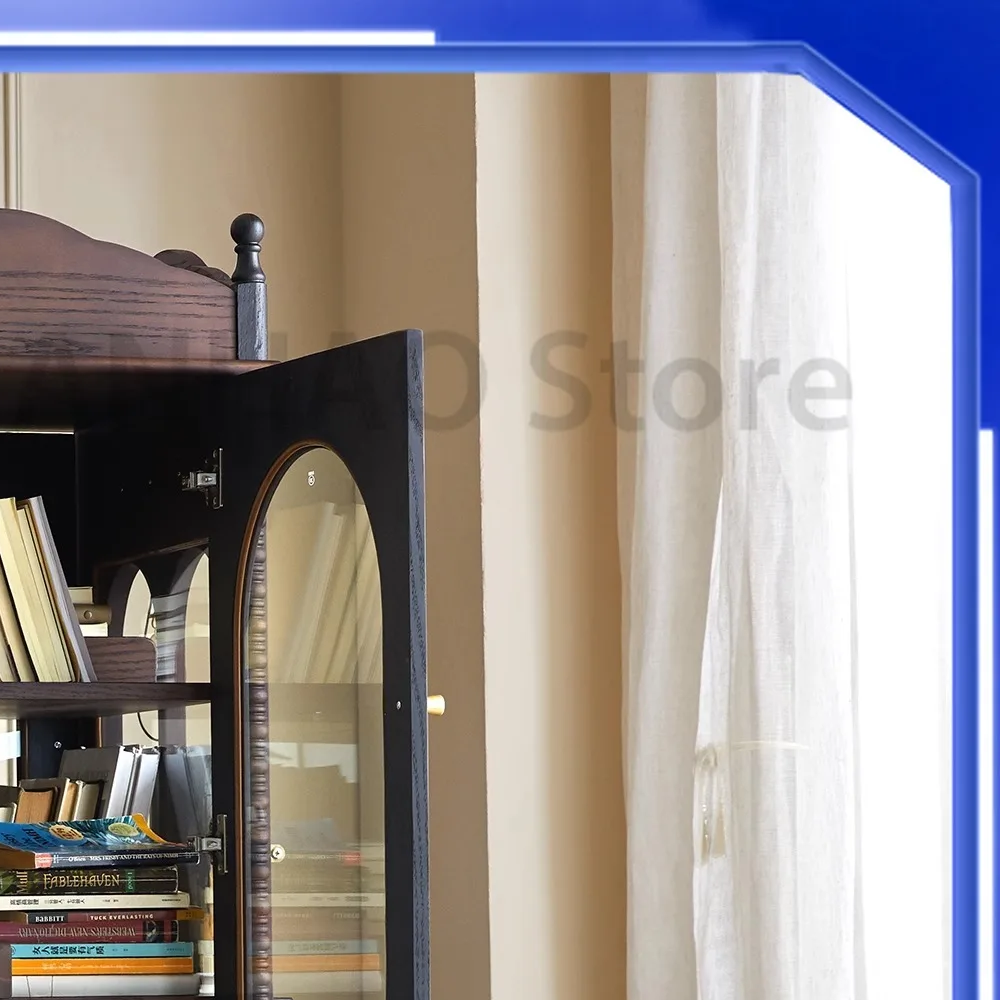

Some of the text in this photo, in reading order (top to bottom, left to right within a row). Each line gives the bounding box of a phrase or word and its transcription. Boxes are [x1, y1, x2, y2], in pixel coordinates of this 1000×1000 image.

[43, 872, 120, 890] FABLEHAVEN
[19, 927, 67, 938] DICTIONARY
[70, 927, 88, 937] NEW
[32, 945, 105, 955] 女人就是要有气质
